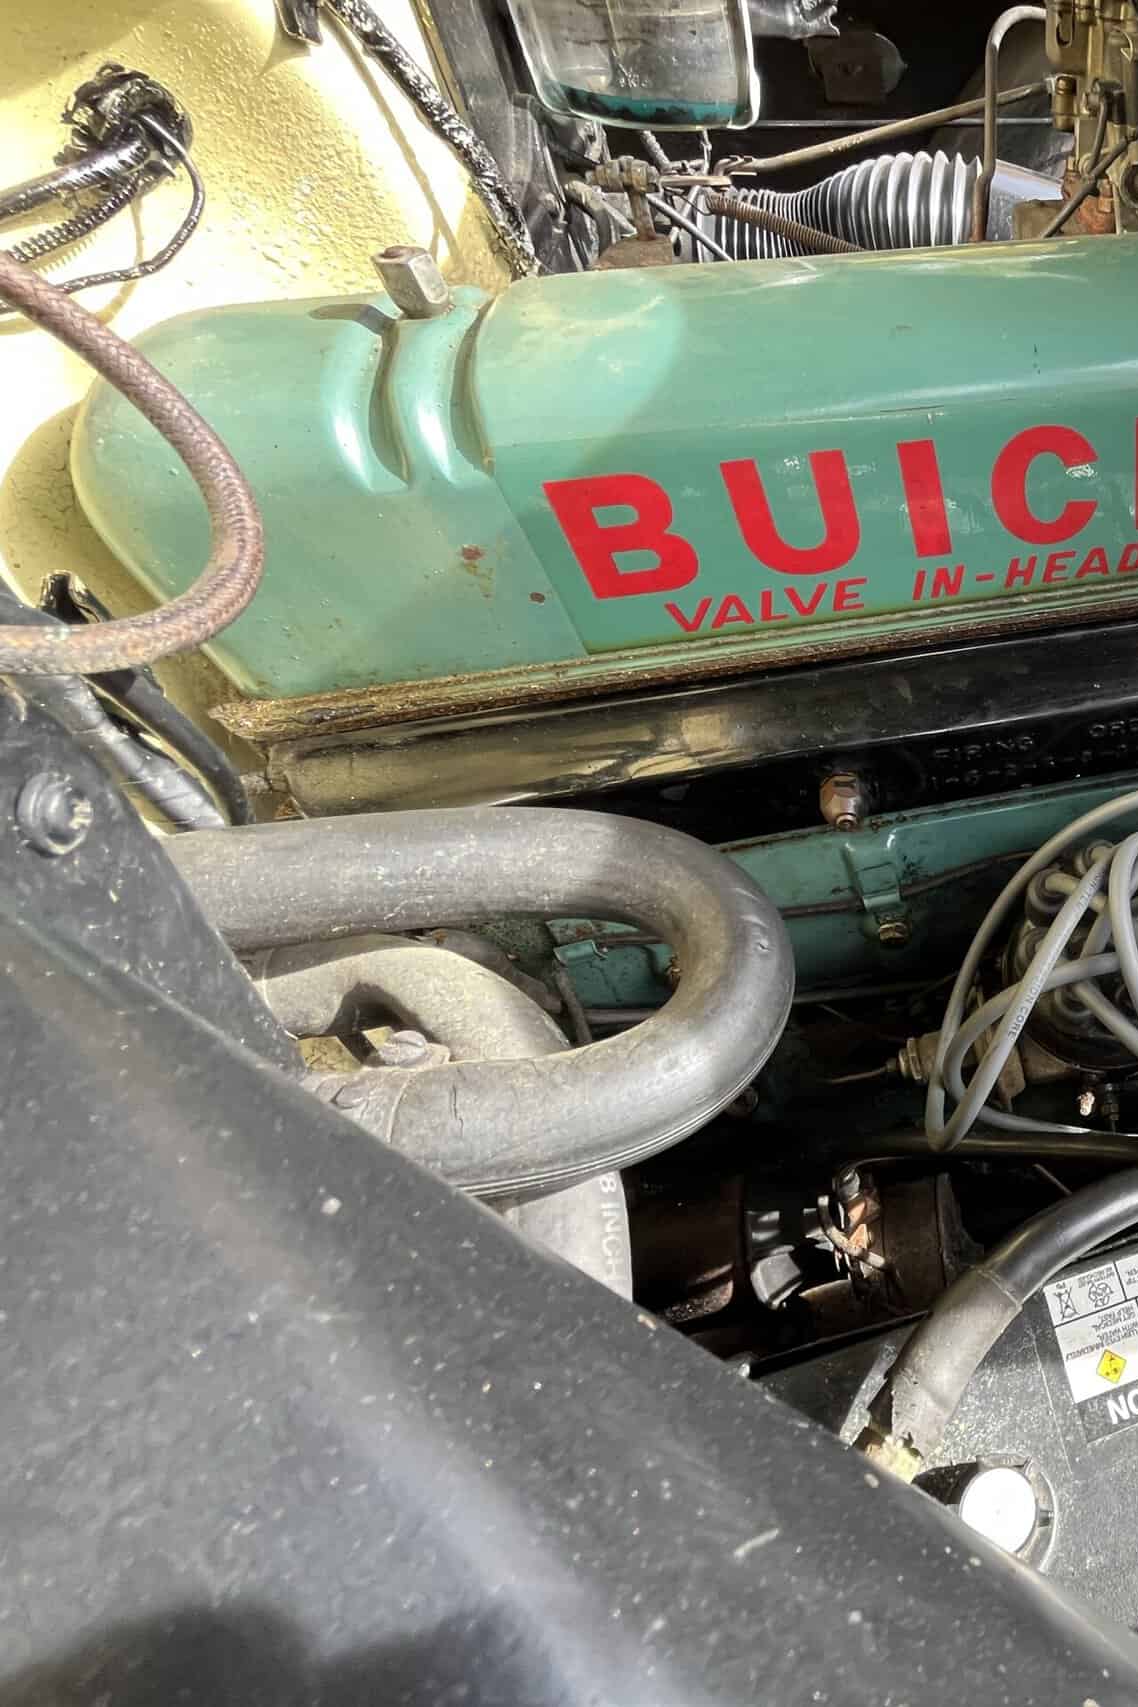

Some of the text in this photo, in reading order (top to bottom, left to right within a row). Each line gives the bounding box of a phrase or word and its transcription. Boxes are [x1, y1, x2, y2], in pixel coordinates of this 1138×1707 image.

[664, 577, 866, 633] VALVE
[1006, 1005, 1030, 1042] CORE
[601, 1202, 625, 1281] INCH
